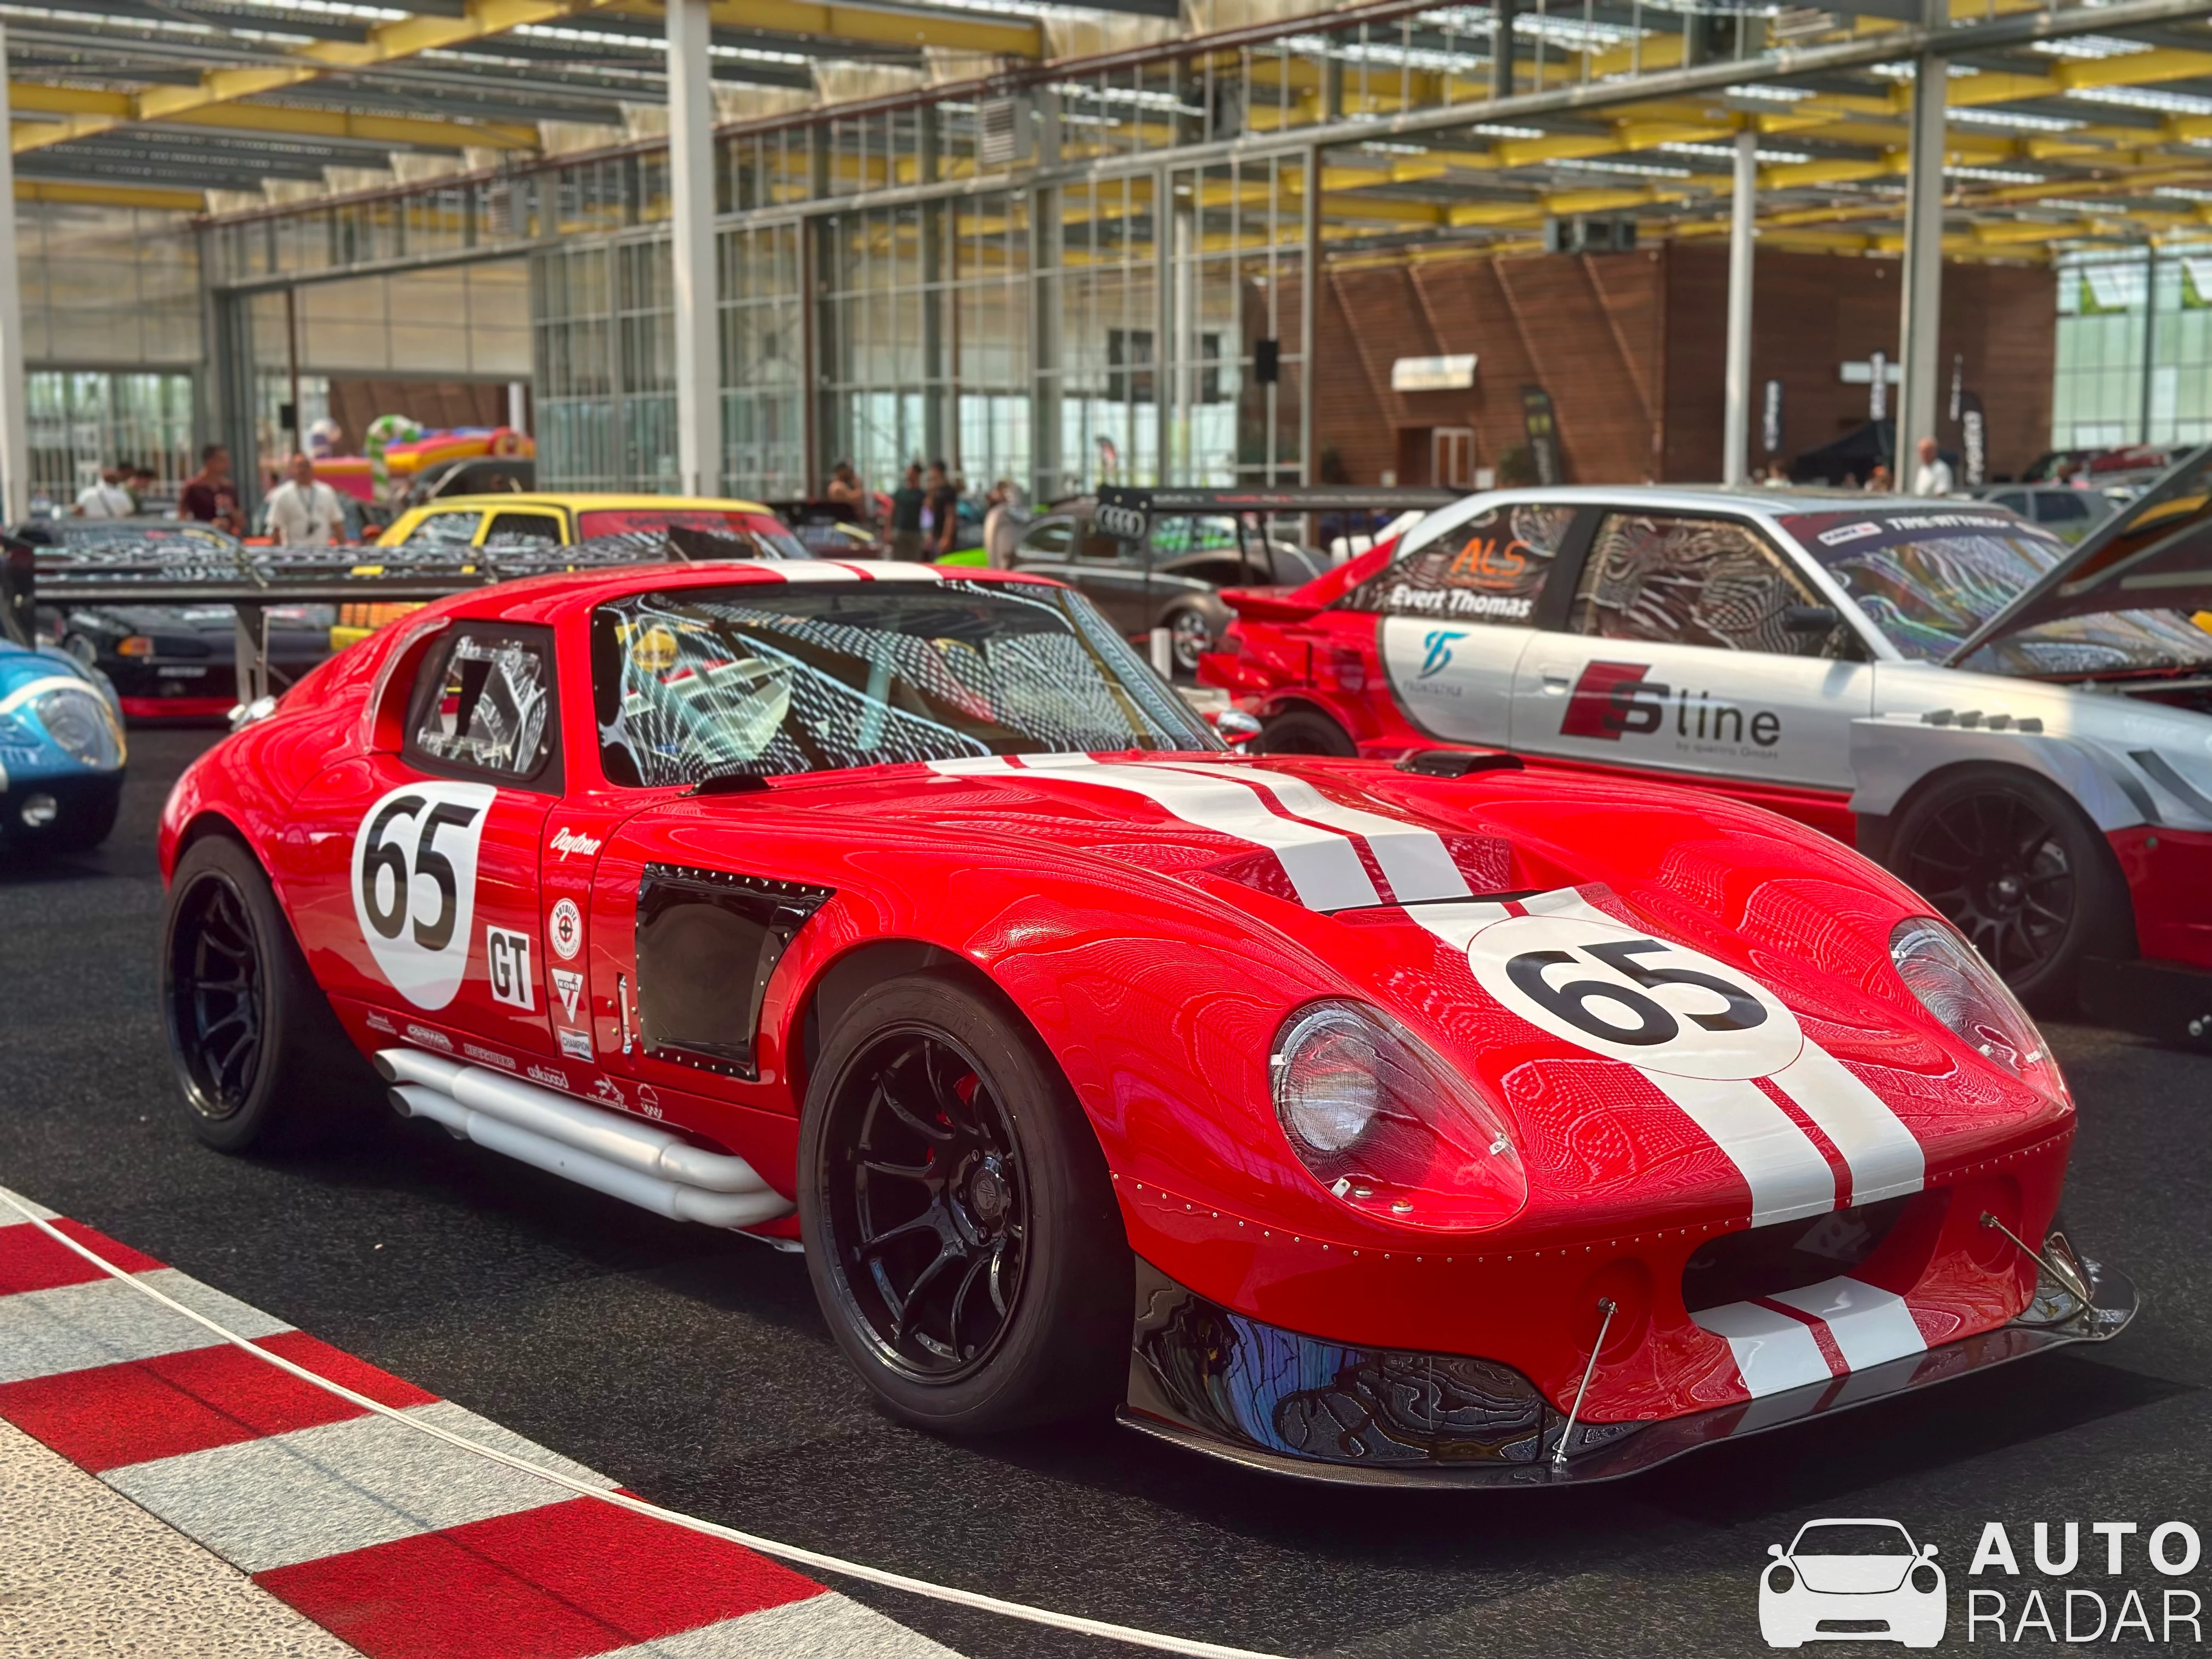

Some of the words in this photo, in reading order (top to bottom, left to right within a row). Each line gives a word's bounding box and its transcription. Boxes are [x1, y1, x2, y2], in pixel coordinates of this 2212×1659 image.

[1449, 536, 1531, 576] ALS
[1390, 584, 1447, 609] Evert
[1448, 588, 1533, 618] Thomas
[1677, 689, 1781, 746] line
[550, 827, 601, 861] Daytona
[362, 795, 481, 952] 65
[556, 905, 577, 922] AUTOLITE
[490, 932, 527, 1003] GT
[558, 980, 578, 991] KONI
[1505, 939, 1768, 1046] 65
[562, 1037, 590, 1052] CHAMPION
